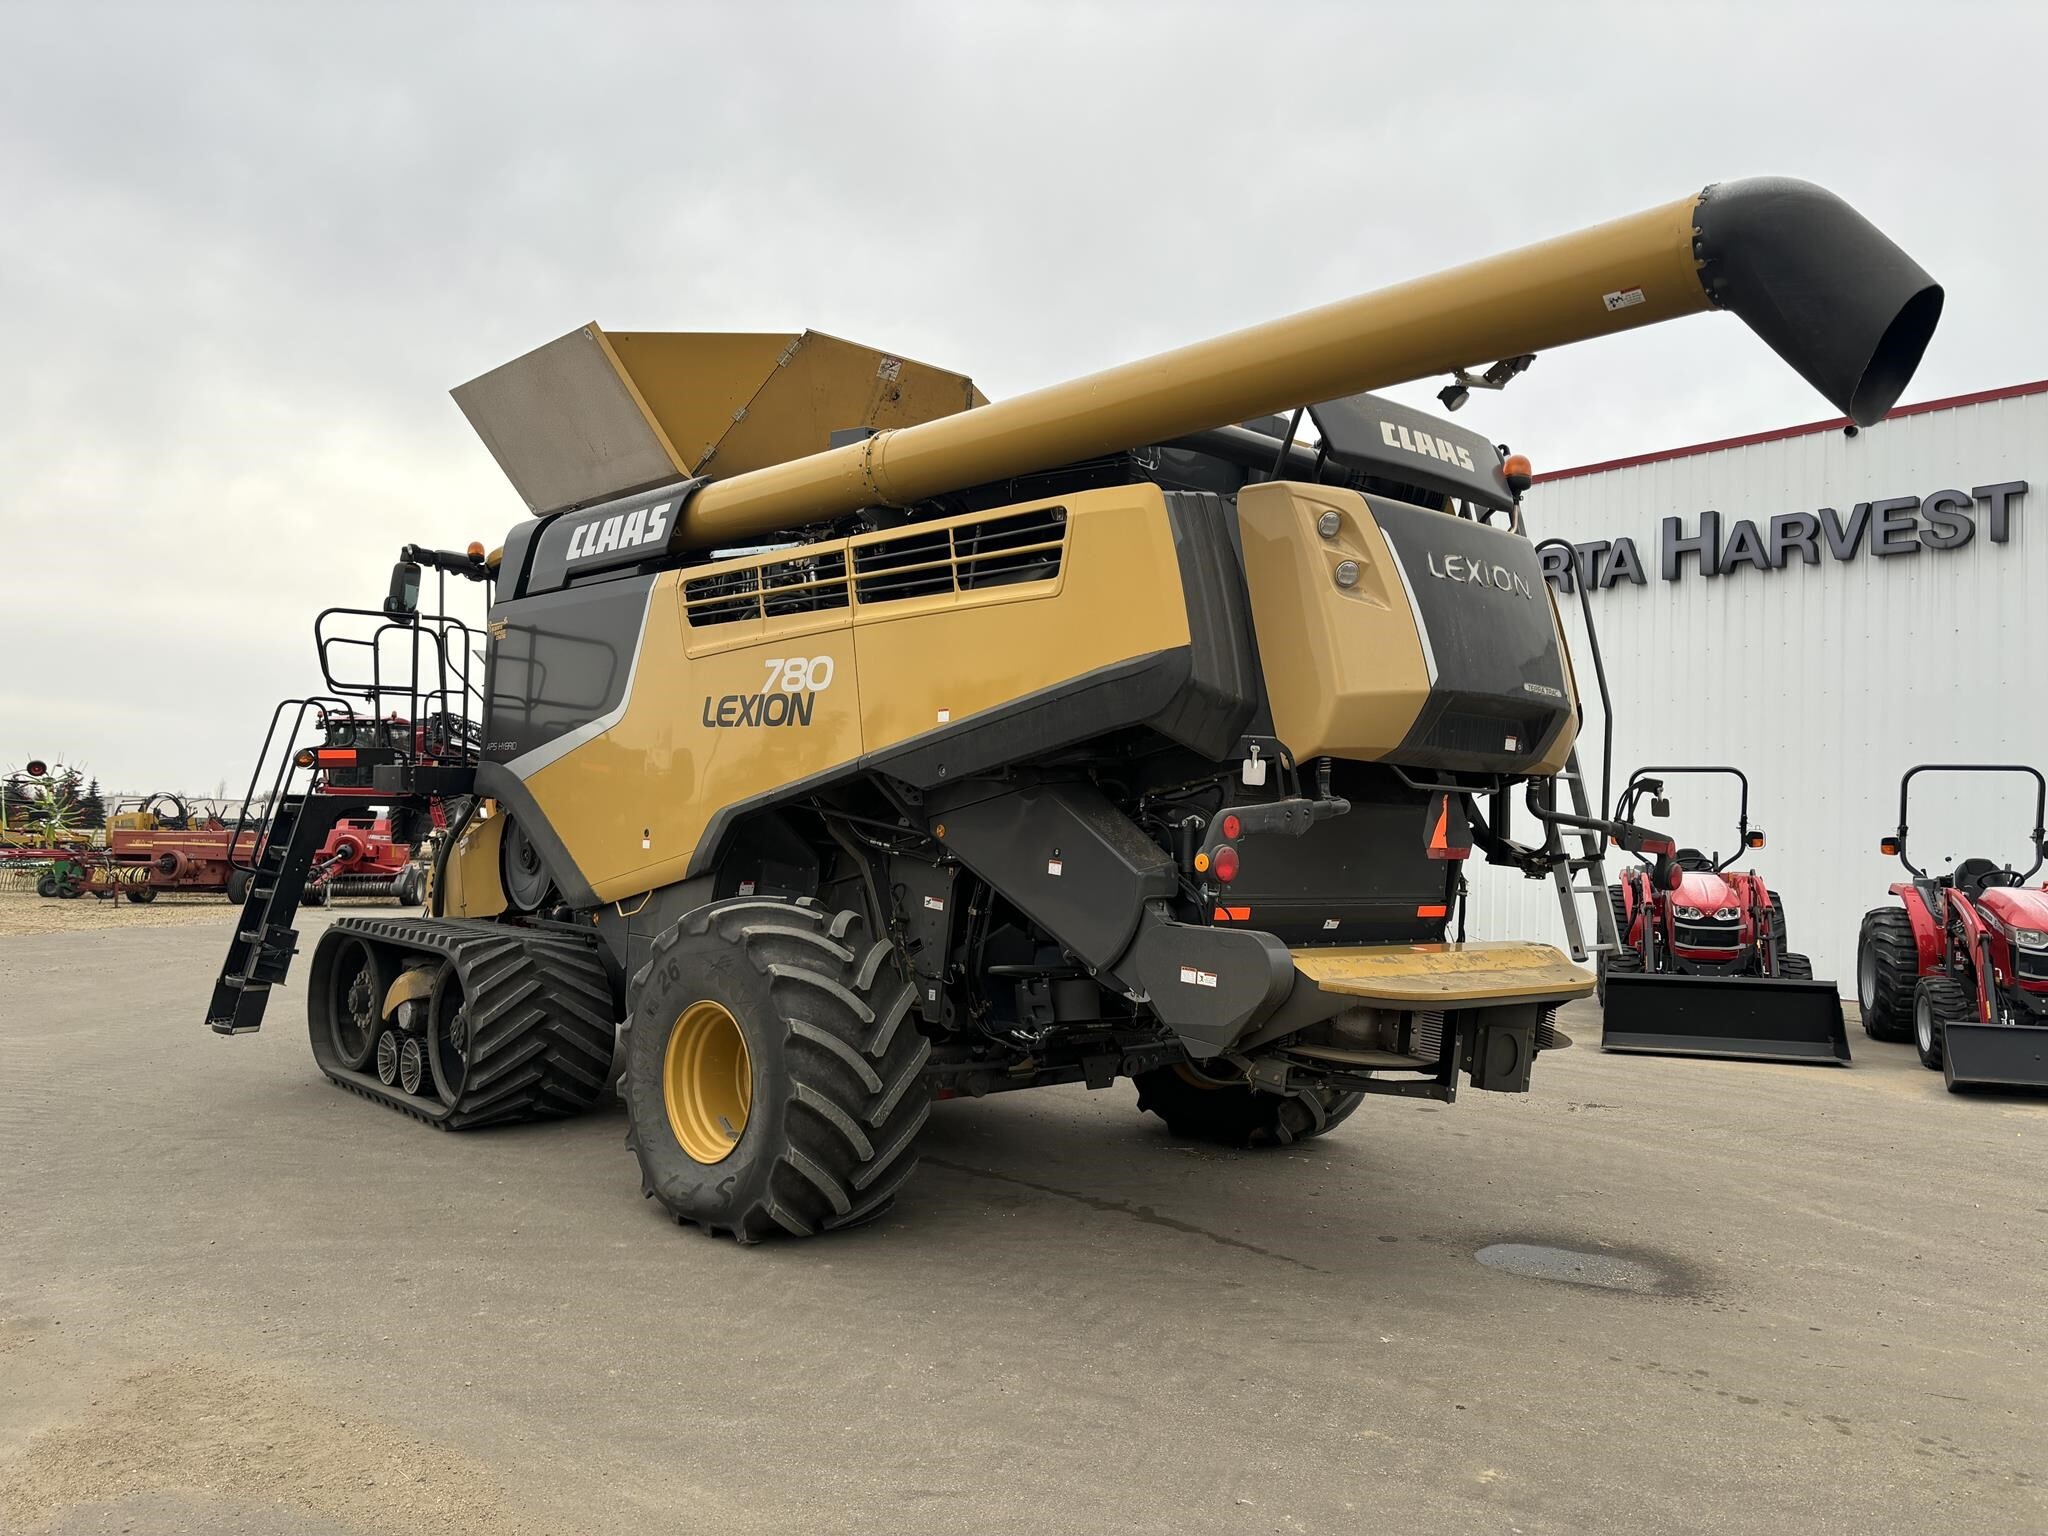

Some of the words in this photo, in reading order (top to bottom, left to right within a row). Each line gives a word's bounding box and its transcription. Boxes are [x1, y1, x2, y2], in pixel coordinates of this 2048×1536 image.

[1380, 421, 1474, 472] CLAAS
[566, 502, 671, 560] CLAAS
[1662, 480, 2028, 581] HARVEST
[1427, 551, 1532, 599] LEXION
[761, 655, 833, 692] 780
[702, 692, 815, 727] LEXION
